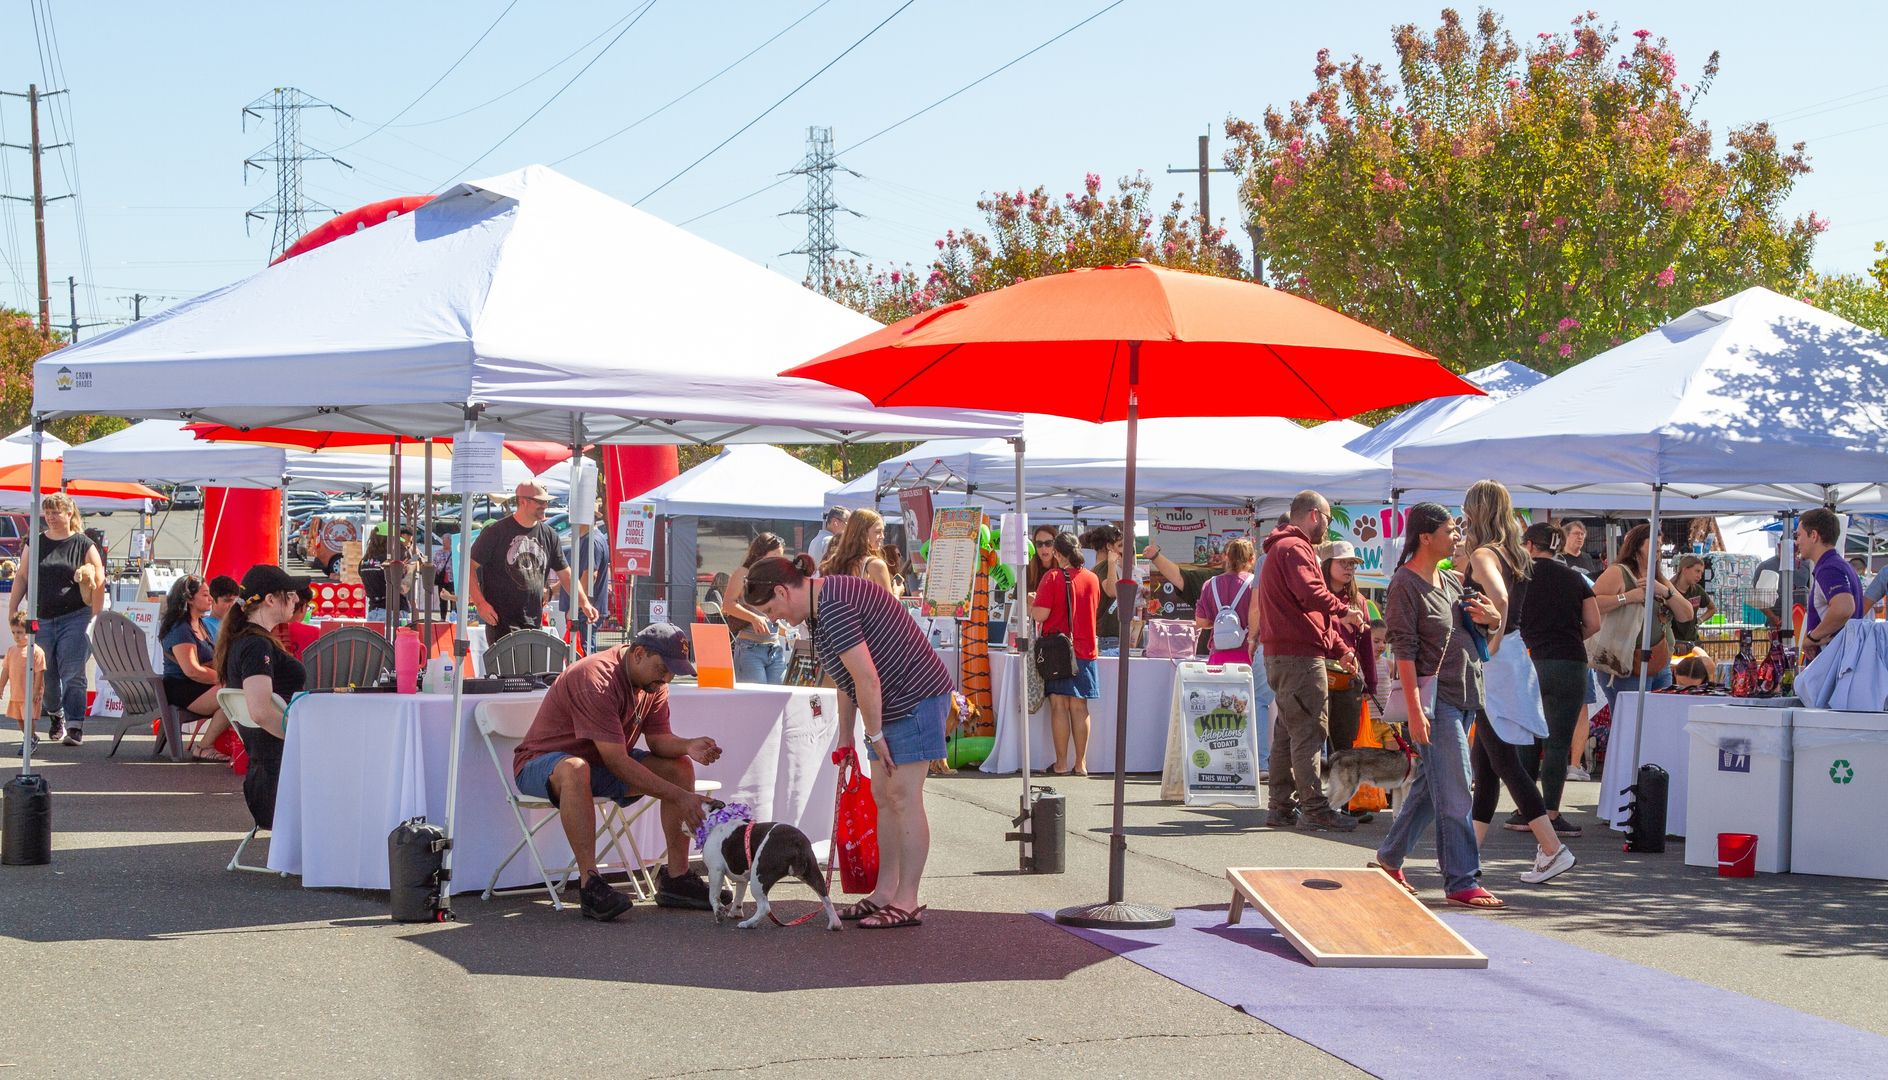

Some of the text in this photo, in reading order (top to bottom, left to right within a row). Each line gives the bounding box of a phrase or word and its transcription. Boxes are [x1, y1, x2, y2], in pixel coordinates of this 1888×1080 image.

[75, 371, 92, 379] CROWN
[75, 380, 92, 388] SHADES
[1166, 511, 1193, 521] nulo
[627, 520, 644, 528] KITTEN
[1159, 523, 1202, 531] Culinary Harvest
[624, 537, 644, 545] PUDDLE
[1354, 546, 1382, 570] AW
[135, 613, 152, 622] FAIR
[1200, 713, 1243, 731] KITTY
[1199, 728, 1244, 742] Adoptions
